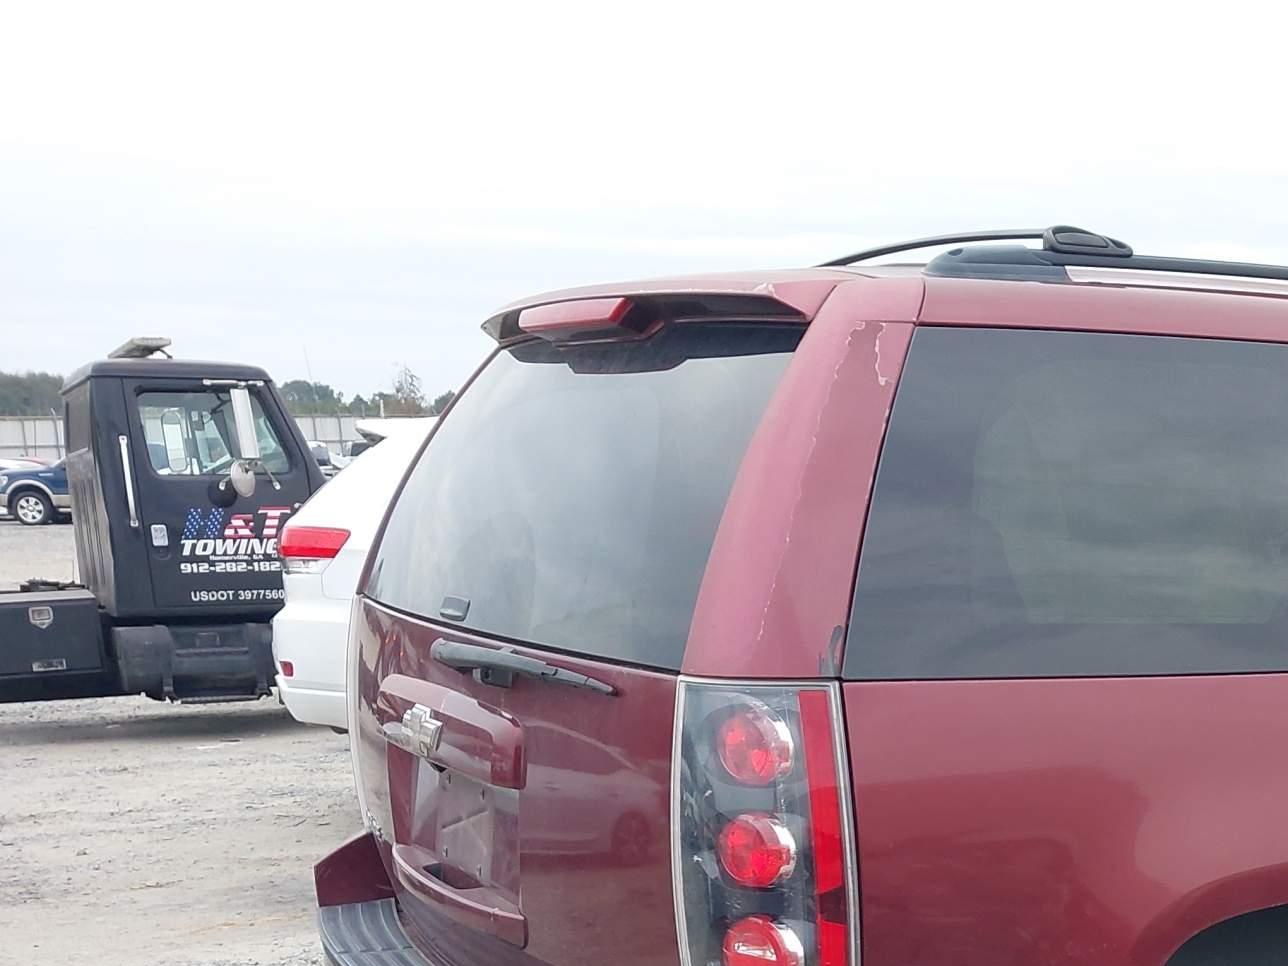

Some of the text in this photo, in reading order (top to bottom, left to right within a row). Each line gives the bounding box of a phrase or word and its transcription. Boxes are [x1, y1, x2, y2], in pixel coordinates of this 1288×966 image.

[180, 561, 281, 573] 912-282-182
[191, 589, 285, 602] USDOT 3977560
